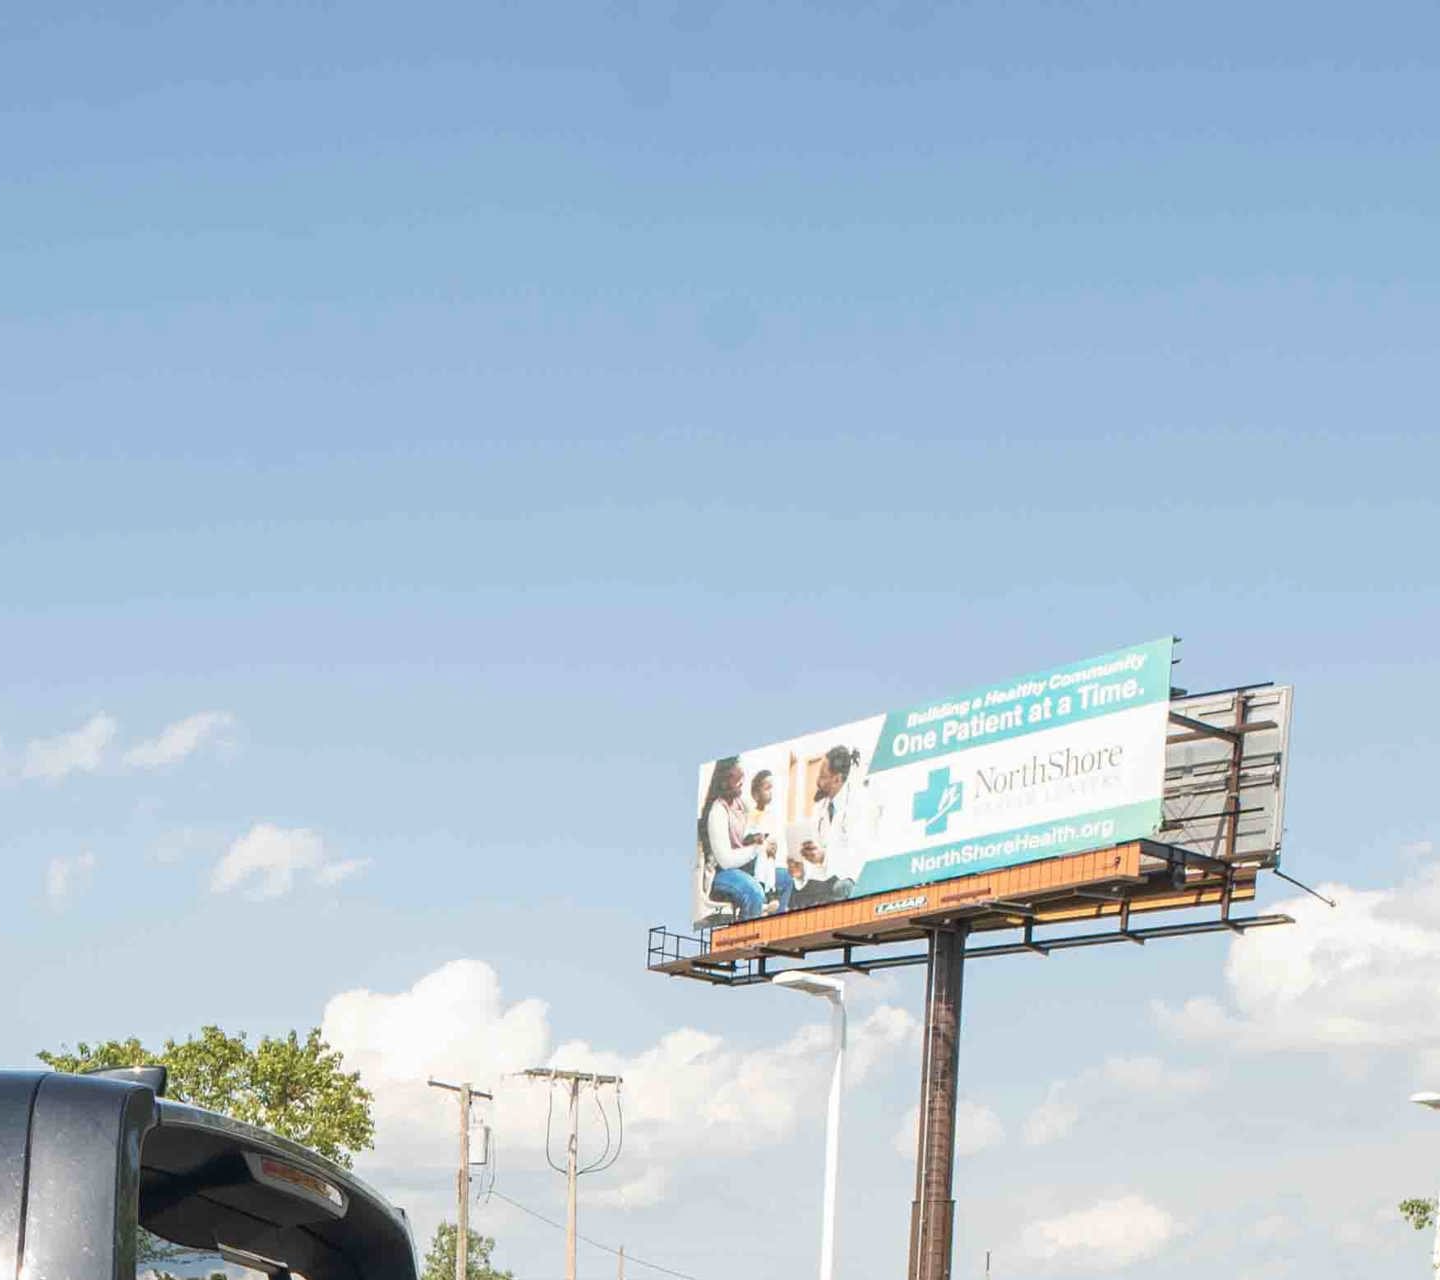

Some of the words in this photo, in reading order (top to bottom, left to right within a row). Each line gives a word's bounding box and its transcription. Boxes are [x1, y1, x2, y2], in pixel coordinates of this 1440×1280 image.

[892, 732, 937, 757] One
[943, 706, 1022, 744] Patient
[1028, 698, 1052, 724] at
[1057, 697, 1071, 716] a
[1078, 677, 1144, 709] Time.
[907, 699, 970, 727] Building
[971, 698, 982, 710] a
[984, 678, 1046, 707] Healthy
[1049, 653, 1147, 690] Community
[975, 745, 1124, 799] NorthShore
[911, 820, 1114, 874] NorthShoreHealth.org
